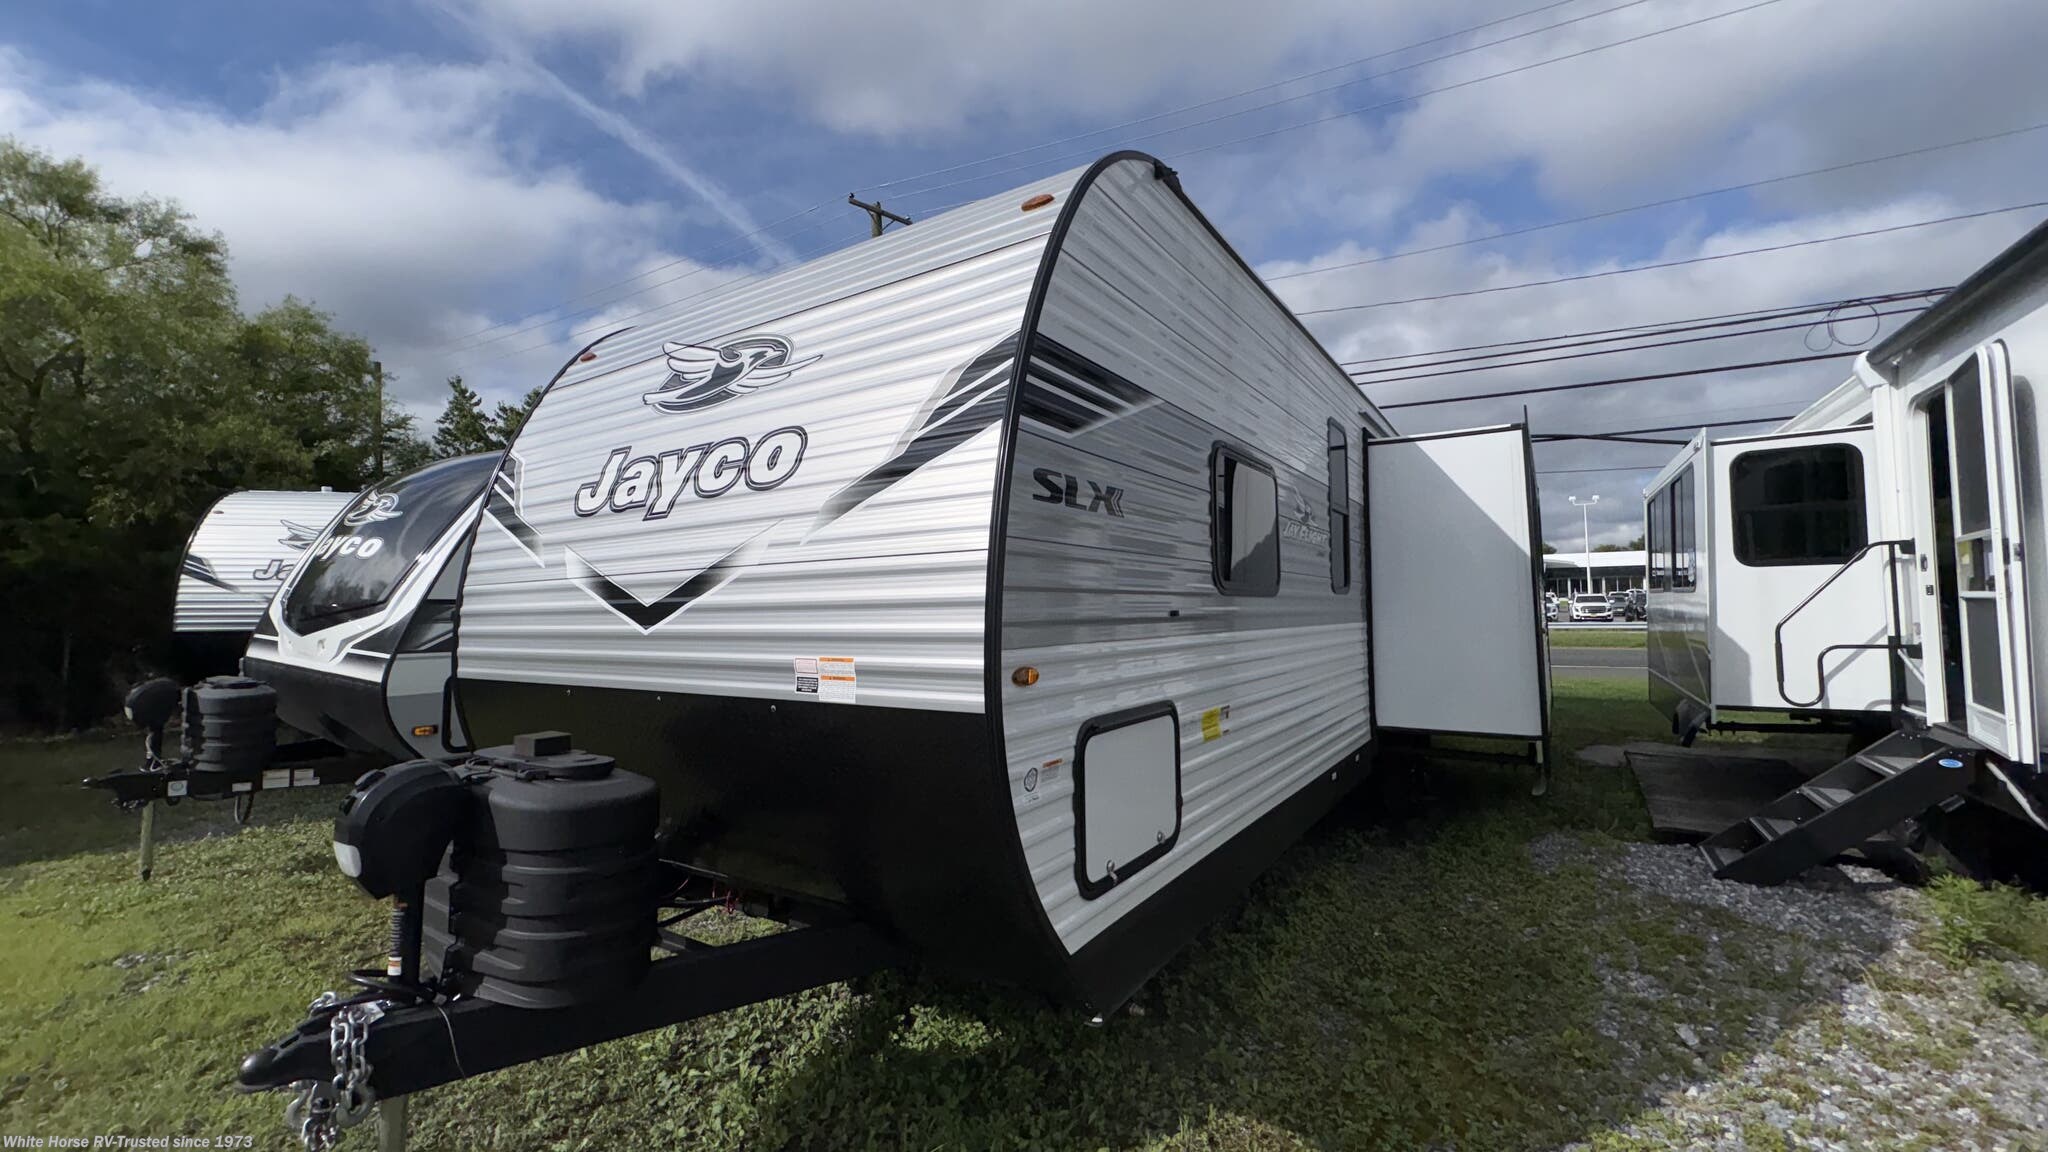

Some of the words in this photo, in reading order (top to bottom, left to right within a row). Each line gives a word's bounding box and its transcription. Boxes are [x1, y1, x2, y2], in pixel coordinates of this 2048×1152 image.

[574, 425, 808, 521] Jayco
[1032, 467, 1125, 518] SLX
[316, 534, 384, 561] ayco
